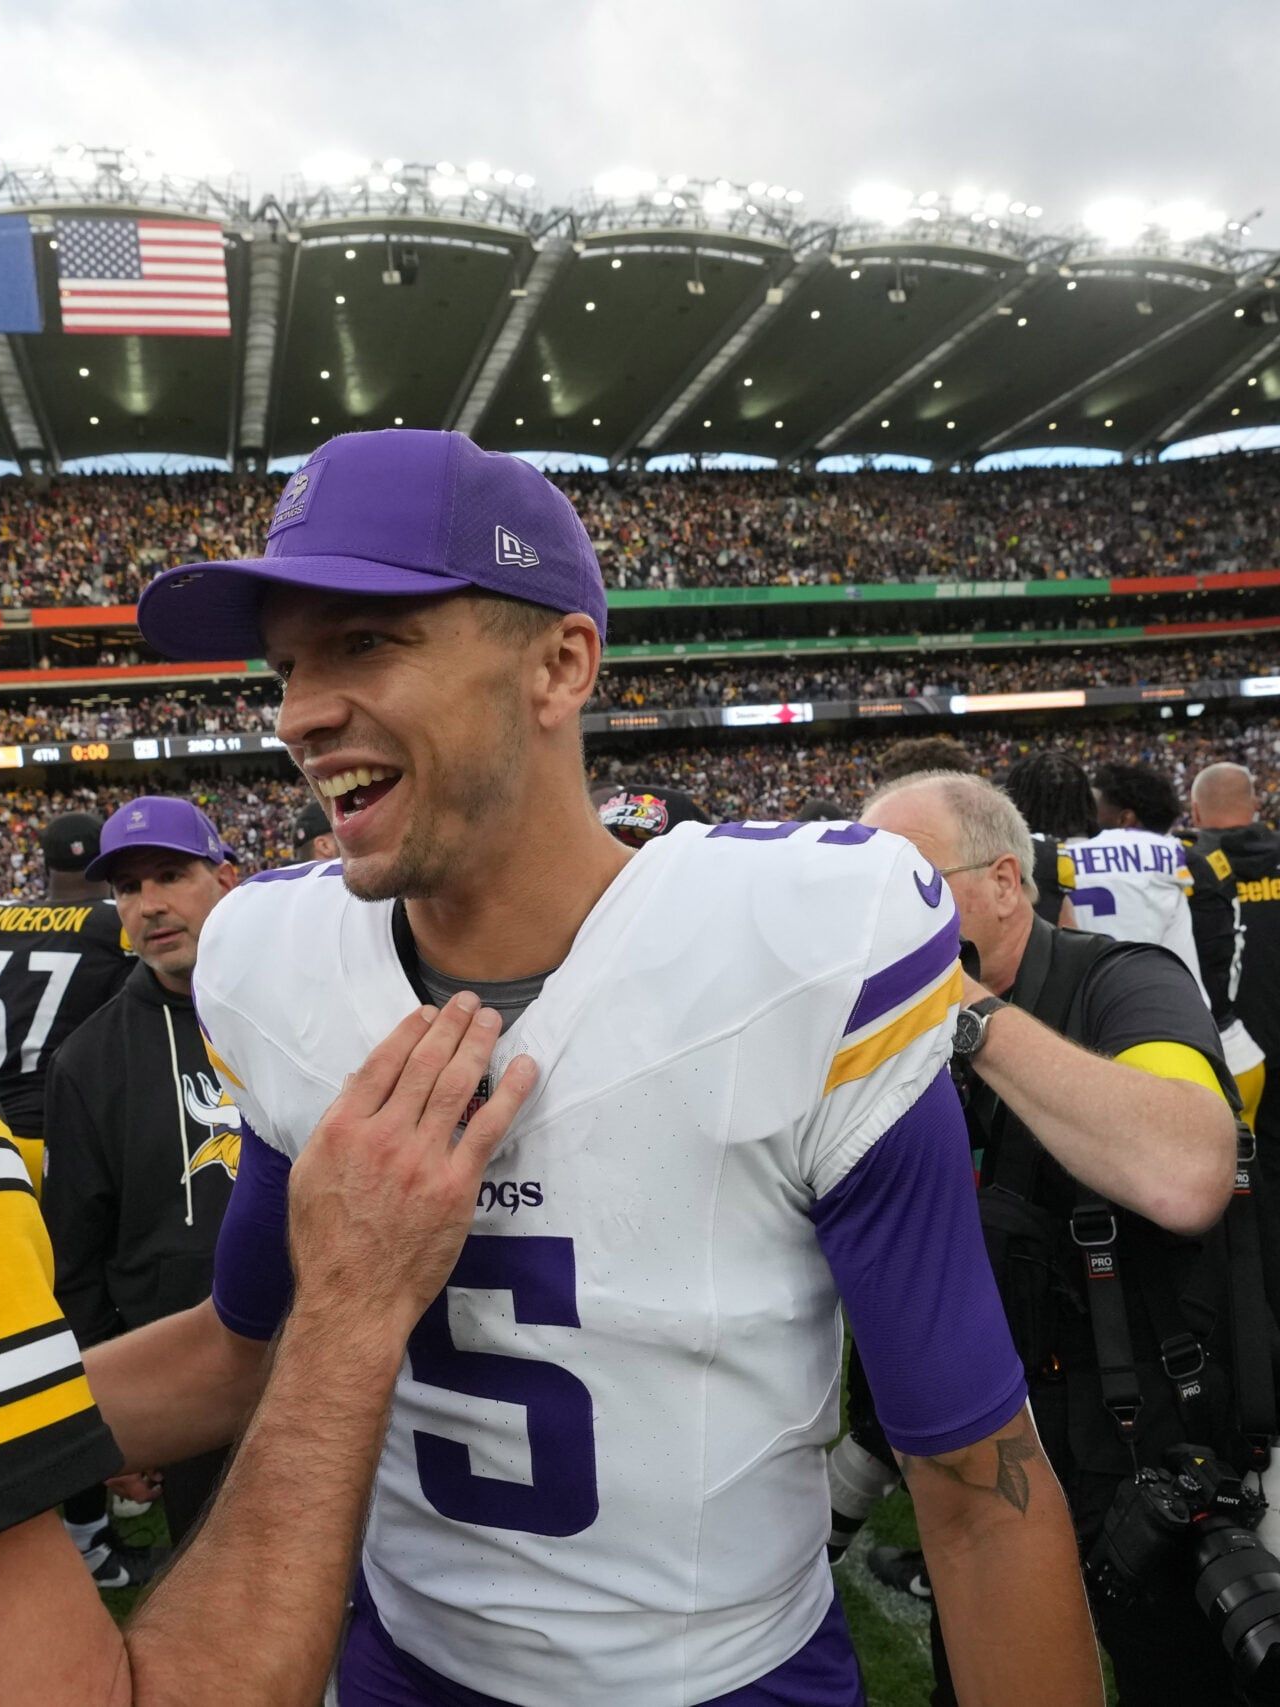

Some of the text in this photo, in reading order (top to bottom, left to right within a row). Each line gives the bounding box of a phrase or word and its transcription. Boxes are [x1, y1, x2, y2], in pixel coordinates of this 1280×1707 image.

[32, 748, 60, 763] 4TH
[70, 743, 109, 761] 0:00
[187, 739, 214, 753] 2ND
[1070, 844, 1142, 876] HERN
[1091, 1257, 1113, 1268] PRO
[406, 1234, 600, 1538] 5
[1182, 1384, 1201, 1399] PRO
[1216, 1495, 1241, 1505] SONY
